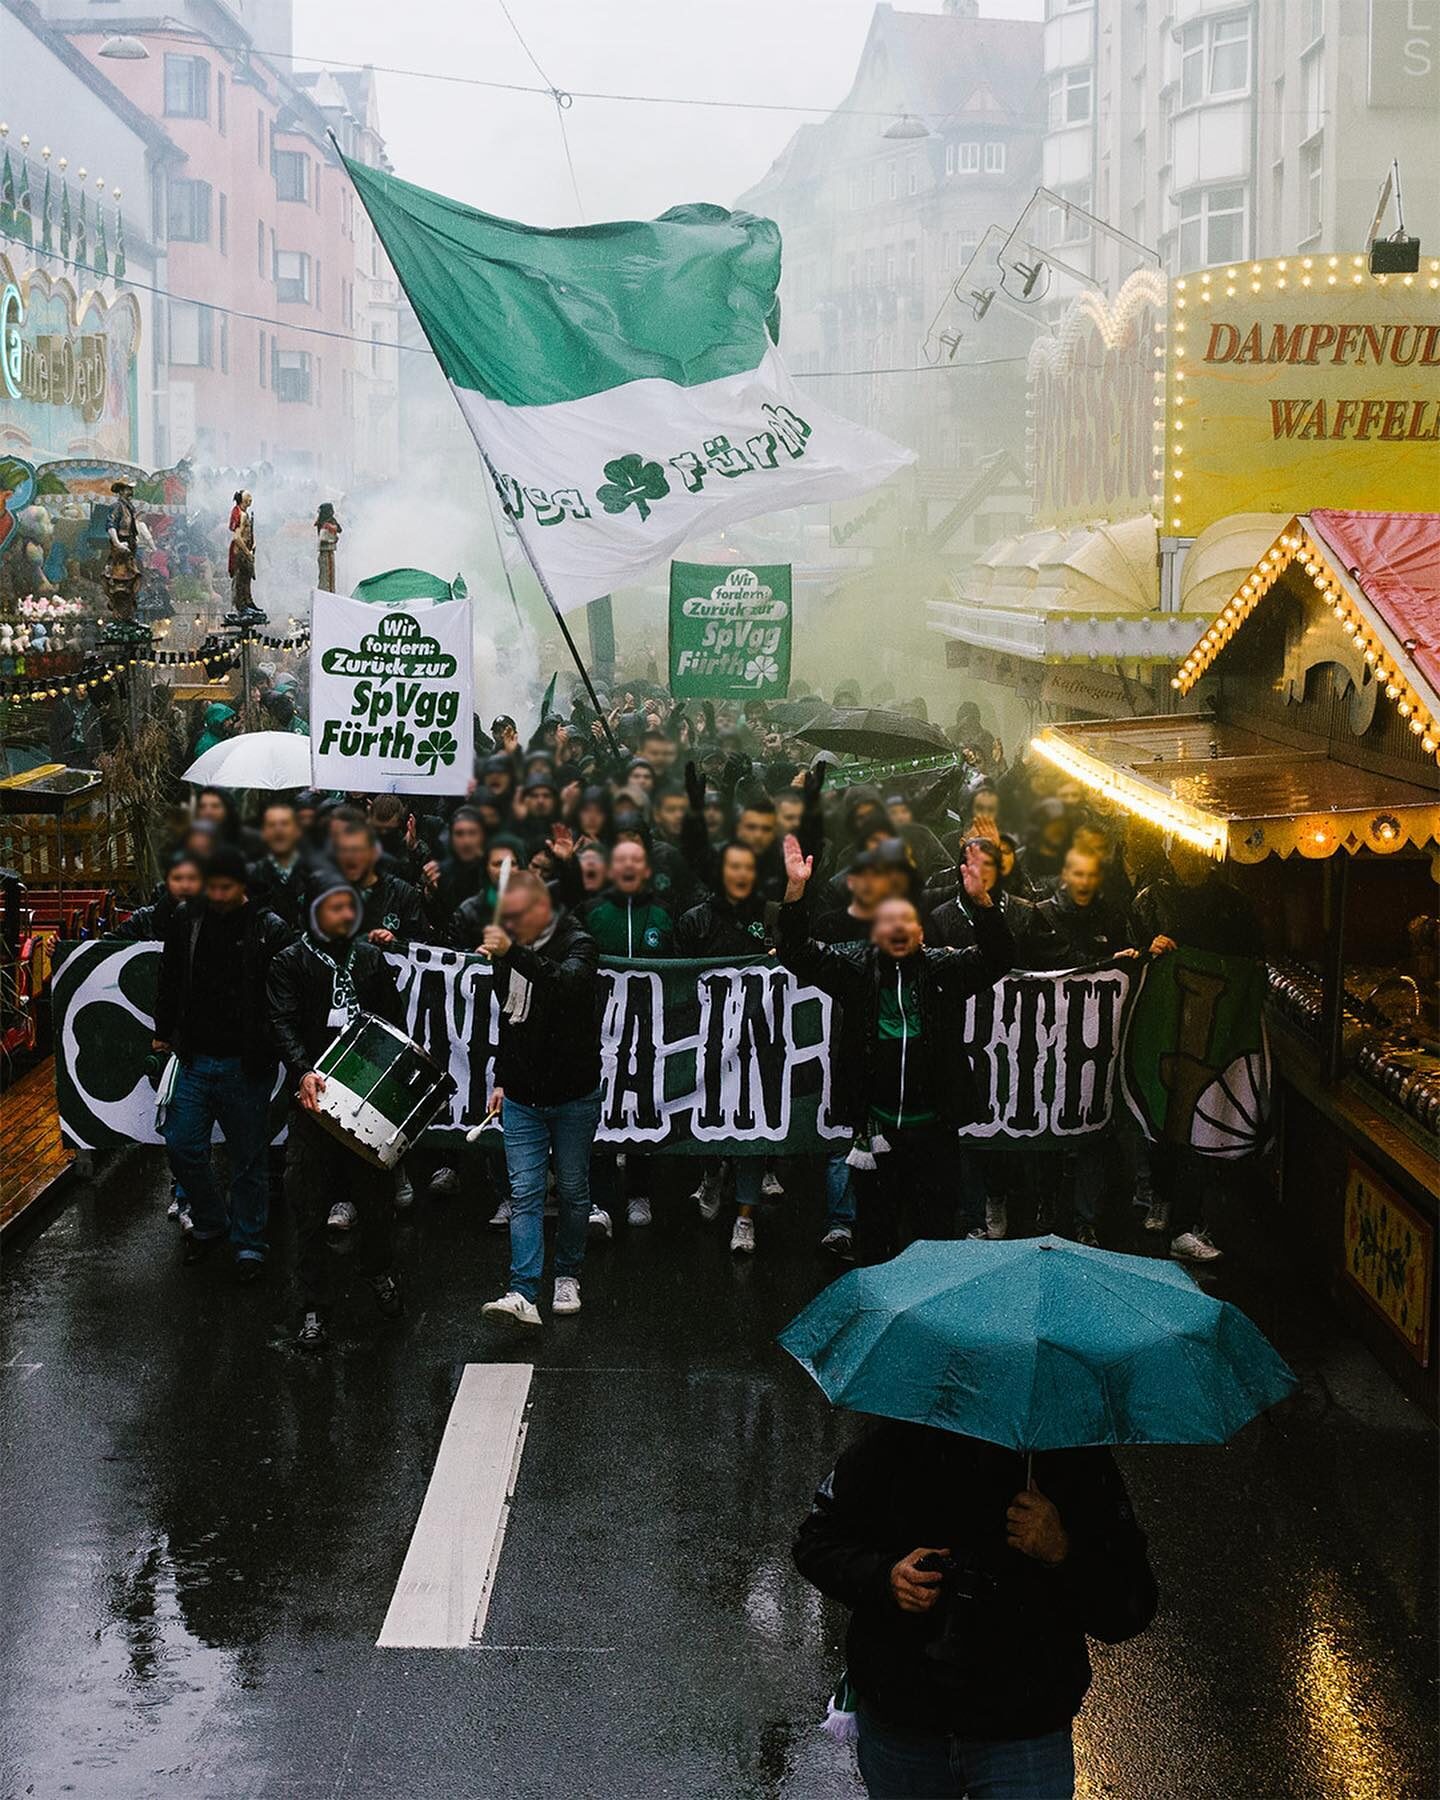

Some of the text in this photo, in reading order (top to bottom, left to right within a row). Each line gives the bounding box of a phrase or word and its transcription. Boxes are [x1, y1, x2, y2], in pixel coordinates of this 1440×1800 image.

[1268, 398, 1440, 441] WAFFEL
[730, 573, 755, 586] Wir
[715, 588, 769, 600] fordern:
[689, 602, 775, 616] Zurück zur
[383, 619, 417, 637] Wir
[702, 621, 781, 655] SpVgg
[366, 637, 435, 656] fordern:
[330, 652, 450, 676] Zurück zur
[676, 650, 745, 676] Fürth
[351, 680, 460, 728] SpVgg
[318, 720, 415, 760] Fürth
